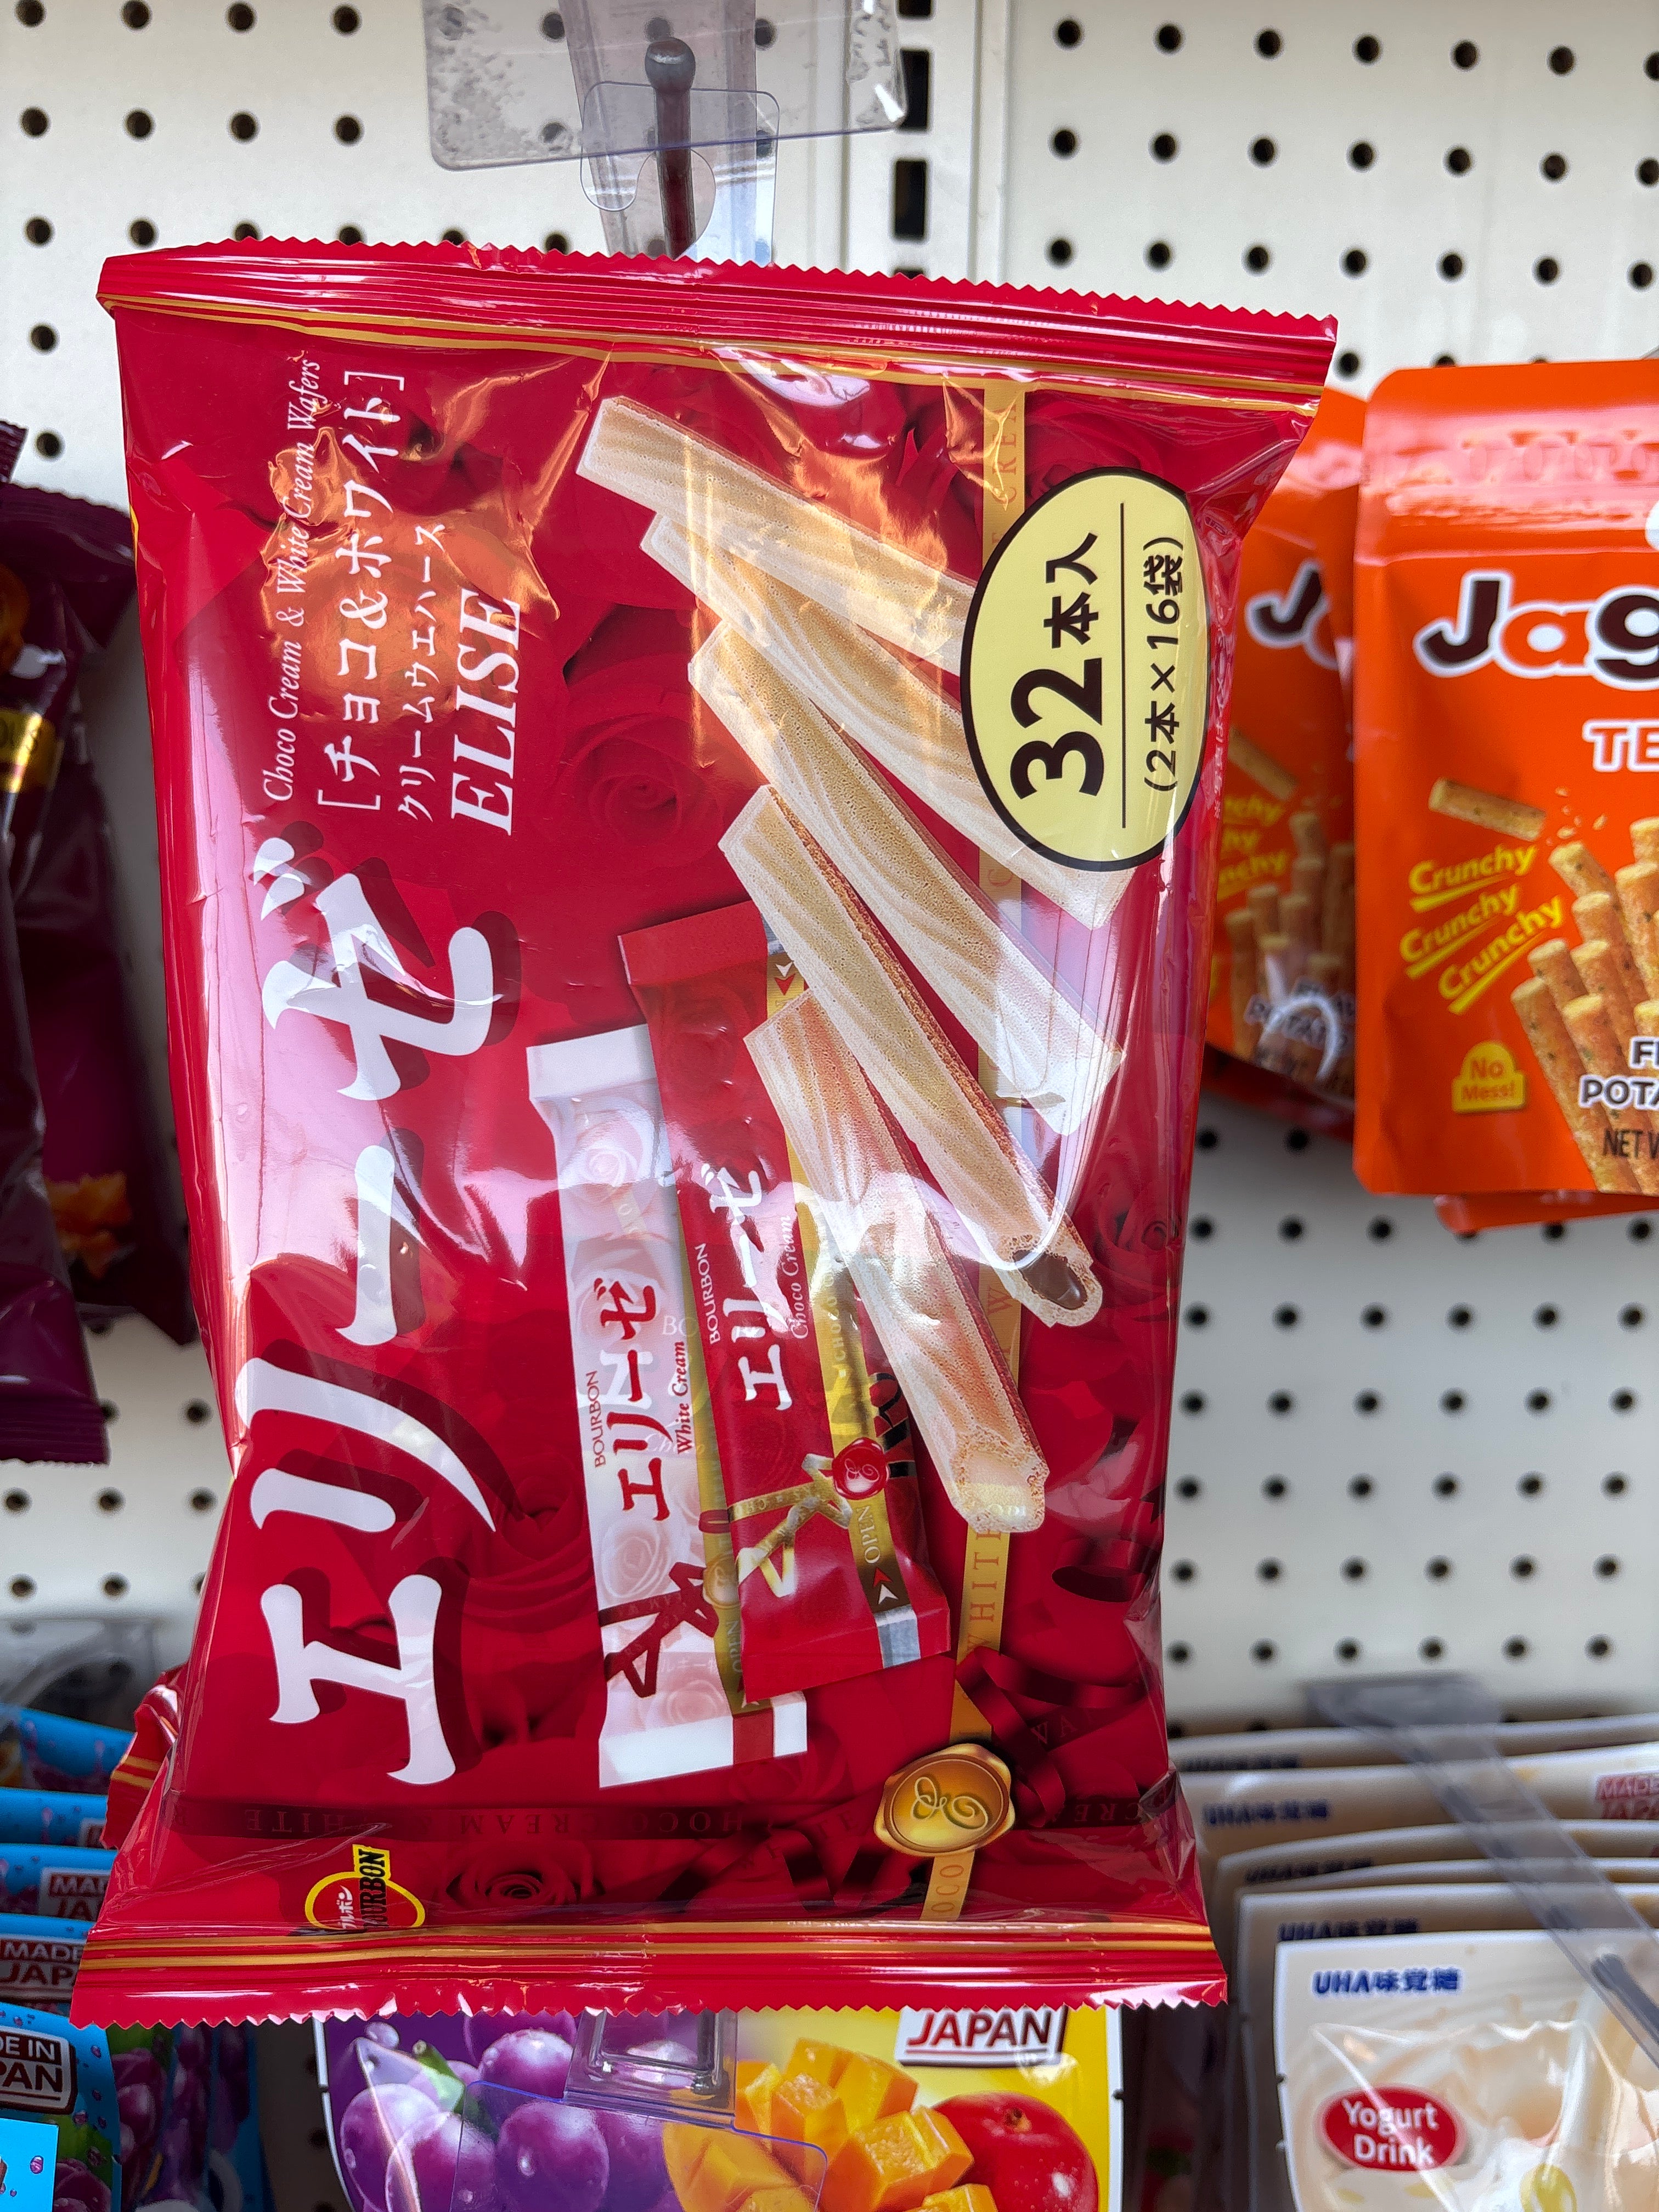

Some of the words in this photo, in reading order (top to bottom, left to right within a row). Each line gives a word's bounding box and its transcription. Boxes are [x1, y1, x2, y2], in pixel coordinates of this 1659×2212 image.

[287, 359, 328, 431] Wafers
[282, 441, 315, 519] Cream
[276, 522, 308, 595] White
[276, 605, 306, 629] &
[269, 640, 302, 720] Cream
[397, 523, 445, 823] クリームウエハース
[1009, 532, 1105, 800] 32本入
[450, 587, 521, 836] ELISE
[263, 729, 297, 802] Choco
[1409, 844, 1537, 894] Crunchy
[1400, 884, 1519, 963] Crunchy
[1438, 895, 1562, 1000] Crunchy
[1471, 1058, 1504, 1079] No
[1602, 1130, 1643, 1159] NET
[778, 1215, 799, 1277] Cream
[234, 834, 496, 1786] エリーゼ
[694, 1243, 721, 1345] BOURBON
[701, 1163, 793, 1410] エリーゼ
[788, 1282, 809, 1339] Choco
[594, 1278, 673, 1521] エリーゼ
[671, 1341, 690, 1397] Cream
[585, 1370, 606, 1468] BOURBON
[675, 1403, 693, 1454] White
[855, 1505, 881, 1564] OPEN
[1313, 1967, 1461, 1996] UHA味覚糖
[28, 2039, 55, 2061] IN
[907, 2007, 1052, 2049] JAPAN
[1341, 2099, 1439, 2136] Yogurt
[1353, 2133, 1434, 2166] Drink
